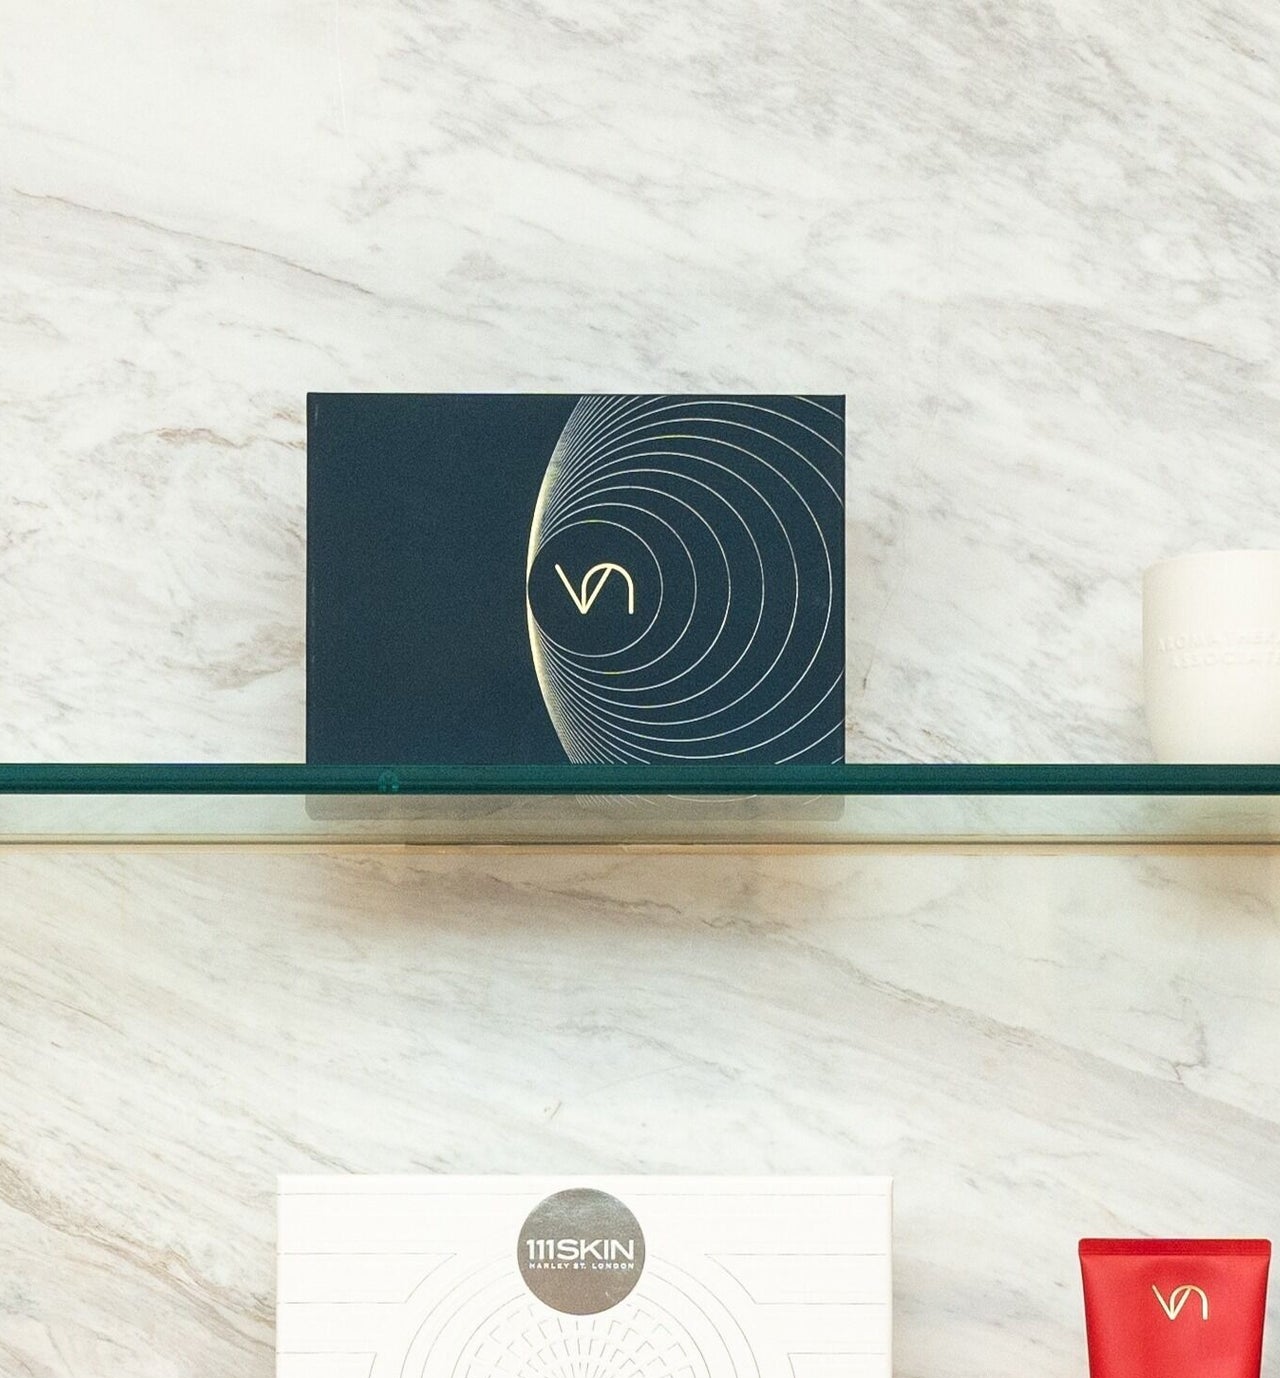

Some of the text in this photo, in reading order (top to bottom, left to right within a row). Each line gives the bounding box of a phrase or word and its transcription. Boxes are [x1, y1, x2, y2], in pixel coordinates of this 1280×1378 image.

[525, 1237, 635, 1261] 111SKIN
[528, 1262, 635, 1271] HARLEY ST. LONDON
